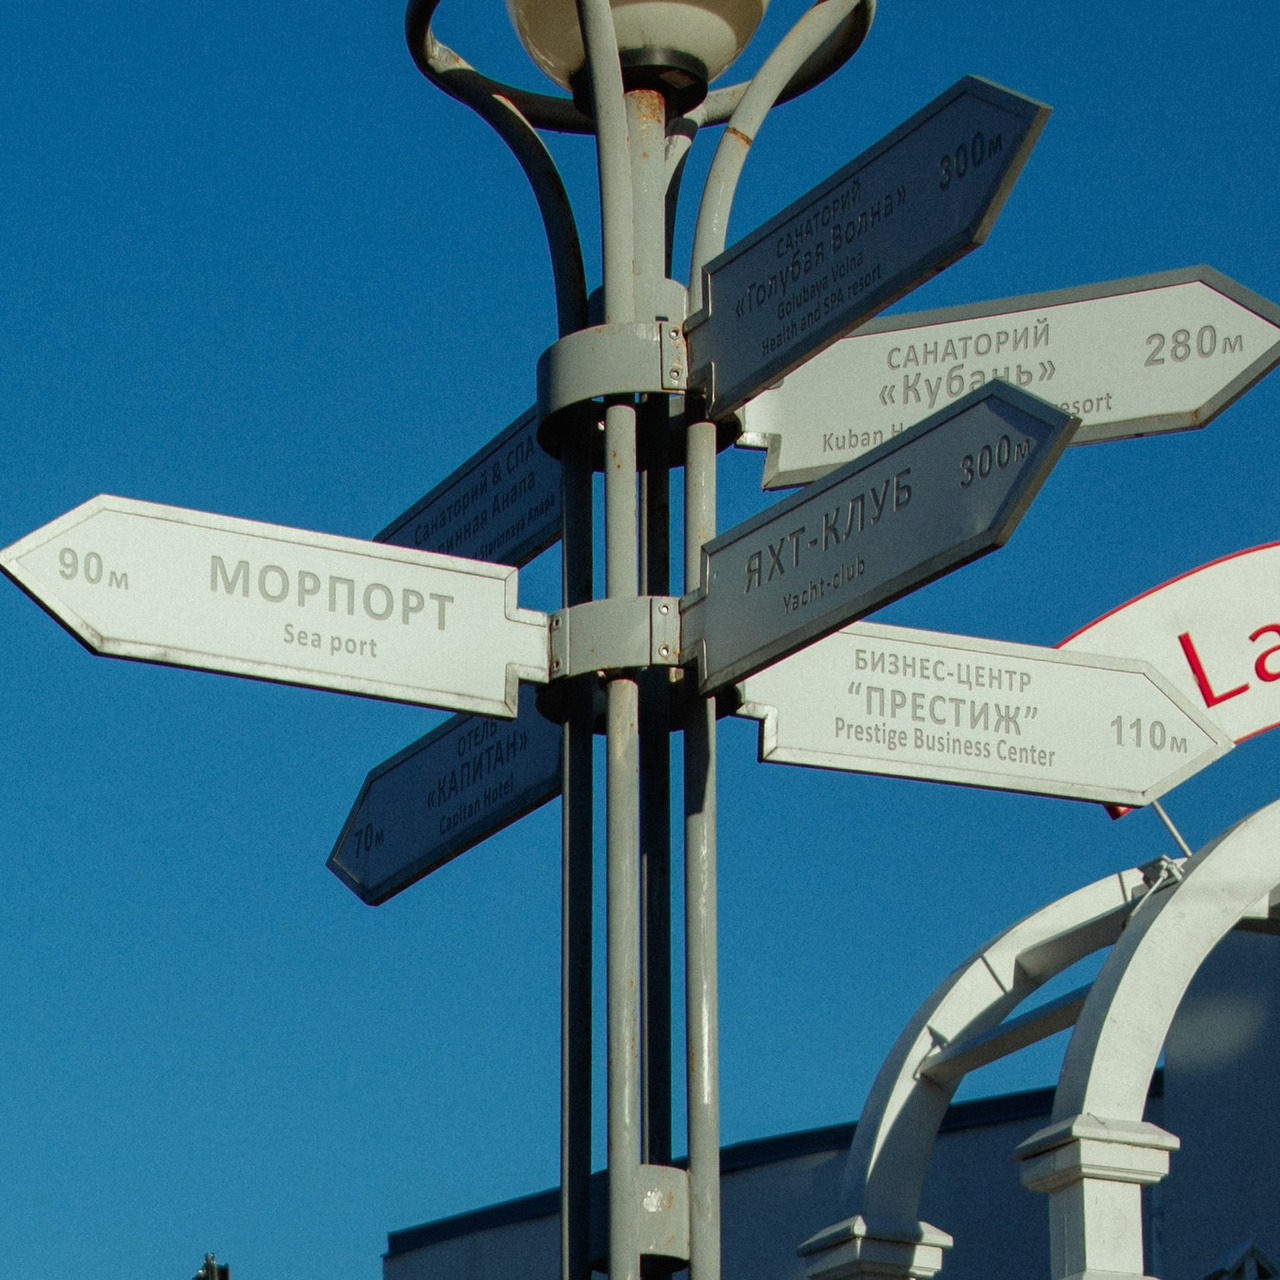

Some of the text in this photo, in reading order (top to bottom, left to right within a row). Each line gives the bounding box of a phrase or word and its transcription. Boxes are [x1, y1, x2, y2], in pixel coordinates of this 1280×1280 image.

[938, 130, 1004, 191] 300м
[776, 177, 862, 259] САНАТОРИЙ
[735, 184, 907, 319] «Голубая Волна»
[761, 264, 882, 357] Health and SPA resort
[776, 252, 864, 321] Golubaya Volna
[886, 318, 1051, 370] САНАТОРИЙ
[1144, 324, 1244, 367] 280м
[1055, 392, 1113, 415] esort
[822, 428, 884, 453] Kuban
[959, 433, 1032, 489] 300м
[414, 434, 536, 546] Санаторий & СПА
[492, 470, 536, 519] Анапа
[526, 492, 556, 531] Anapa
[742, 466, 913, 595] ЯХТ-КЛУБ
[58, 546, 130, 591] 90м
[210, 555, 455, 631] МОРПОРТ
[782, 554, 866, 616] Yacht-club
[283, 622, 378, 660] Sea port
[854, 648, 1033, 693] БИЗНЕС-ЦЕНТР
[457, 719, 498, 757] ОТЕЛЬ
[834, 716, 1056, 768] Prestige Business Center
[1110, 714, 1188, 754] 110м
[426, 730, 529, 811] «КАПИТАН»
[439, 773, 514, 836] Capitan Hotel
[354, 823, 385, 859] 70м
